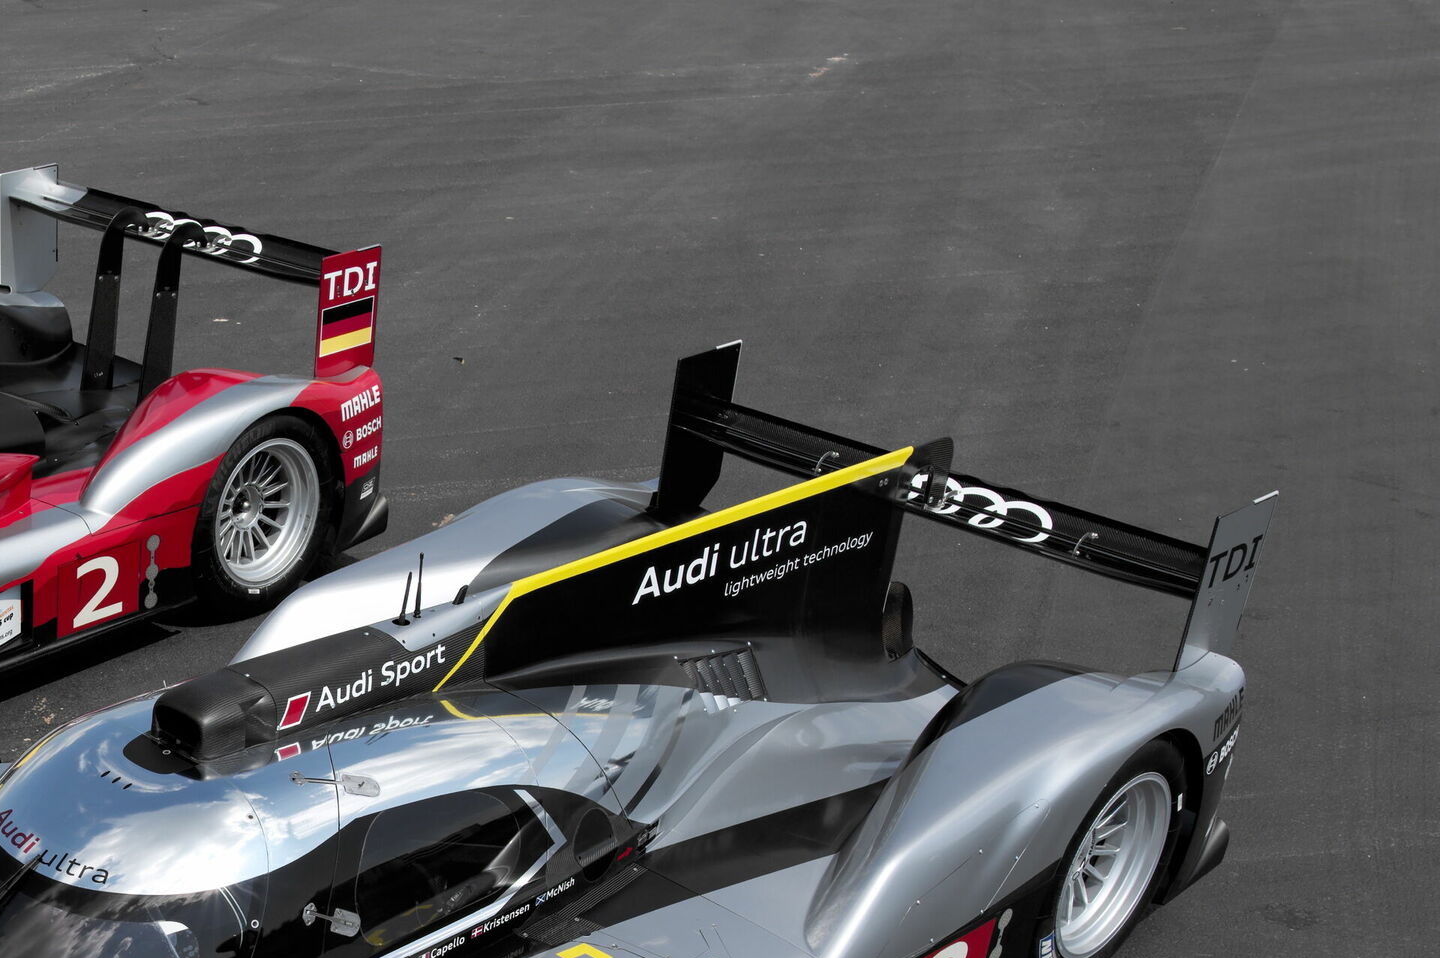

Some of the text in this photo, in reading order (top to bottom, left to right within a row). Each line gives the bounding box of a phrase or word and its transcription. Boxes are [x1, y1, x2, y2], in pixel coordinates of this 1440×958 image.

[323, 261, 378, 301] TDI
[340, 384, 381, 422] MAHLE
[356, 415, 382, 442] BOSCH
[353, 445, 378, 469] MAHLE
[631, 519, 809, 606] Audi ultra
[724, 531, 875, 598] lightweight technology
[1208, 533, 1264, 589] TDI
[73, 556, 123, 629] 2
[315, 643, 447, 714] Audi Sport
[38, 849, 110, 885] ultra
[483, 902, 531, 934] Kristensen
[545, 876, 576, 901] McNish
